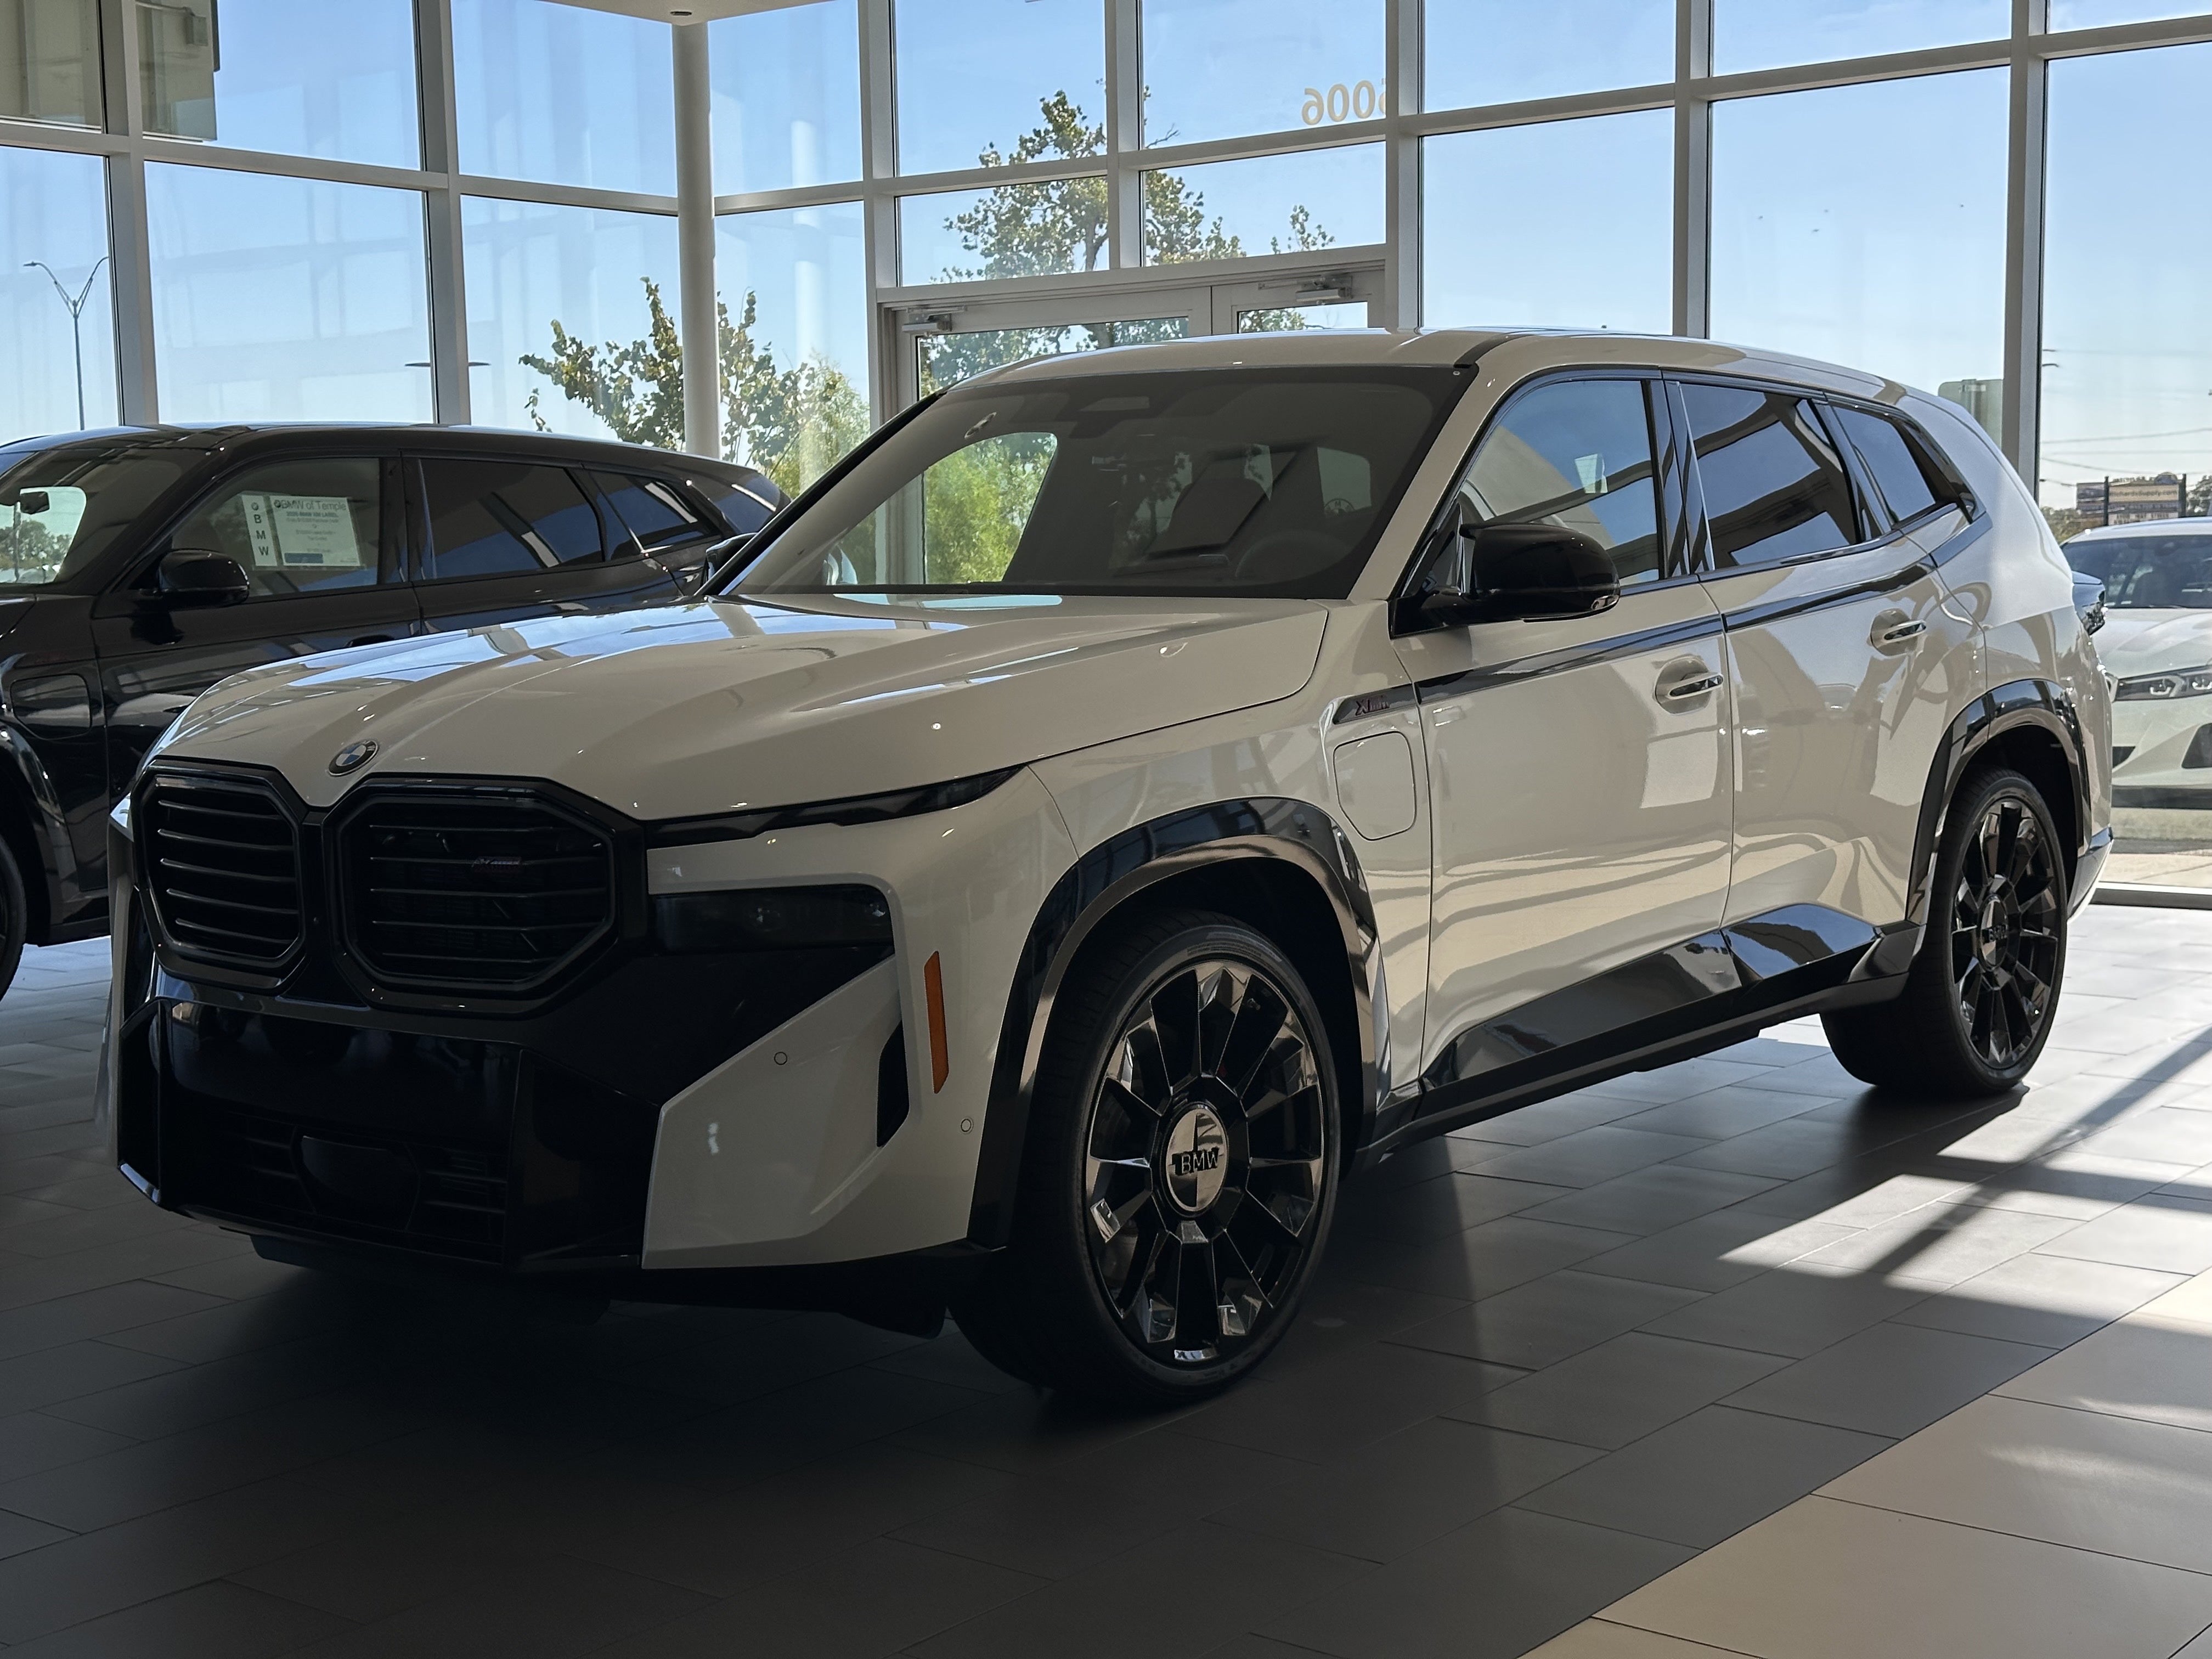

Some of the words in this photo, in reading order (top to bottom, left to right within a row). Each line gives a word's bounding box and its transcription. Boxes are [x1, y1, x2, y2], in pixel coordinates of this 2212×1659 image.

[281, 499, 303, 510] BMW
[306, 500, 314, 510] of
[315, 501, 347, 511] Temple
[1180, 1149, 1220, 1175] BMW
